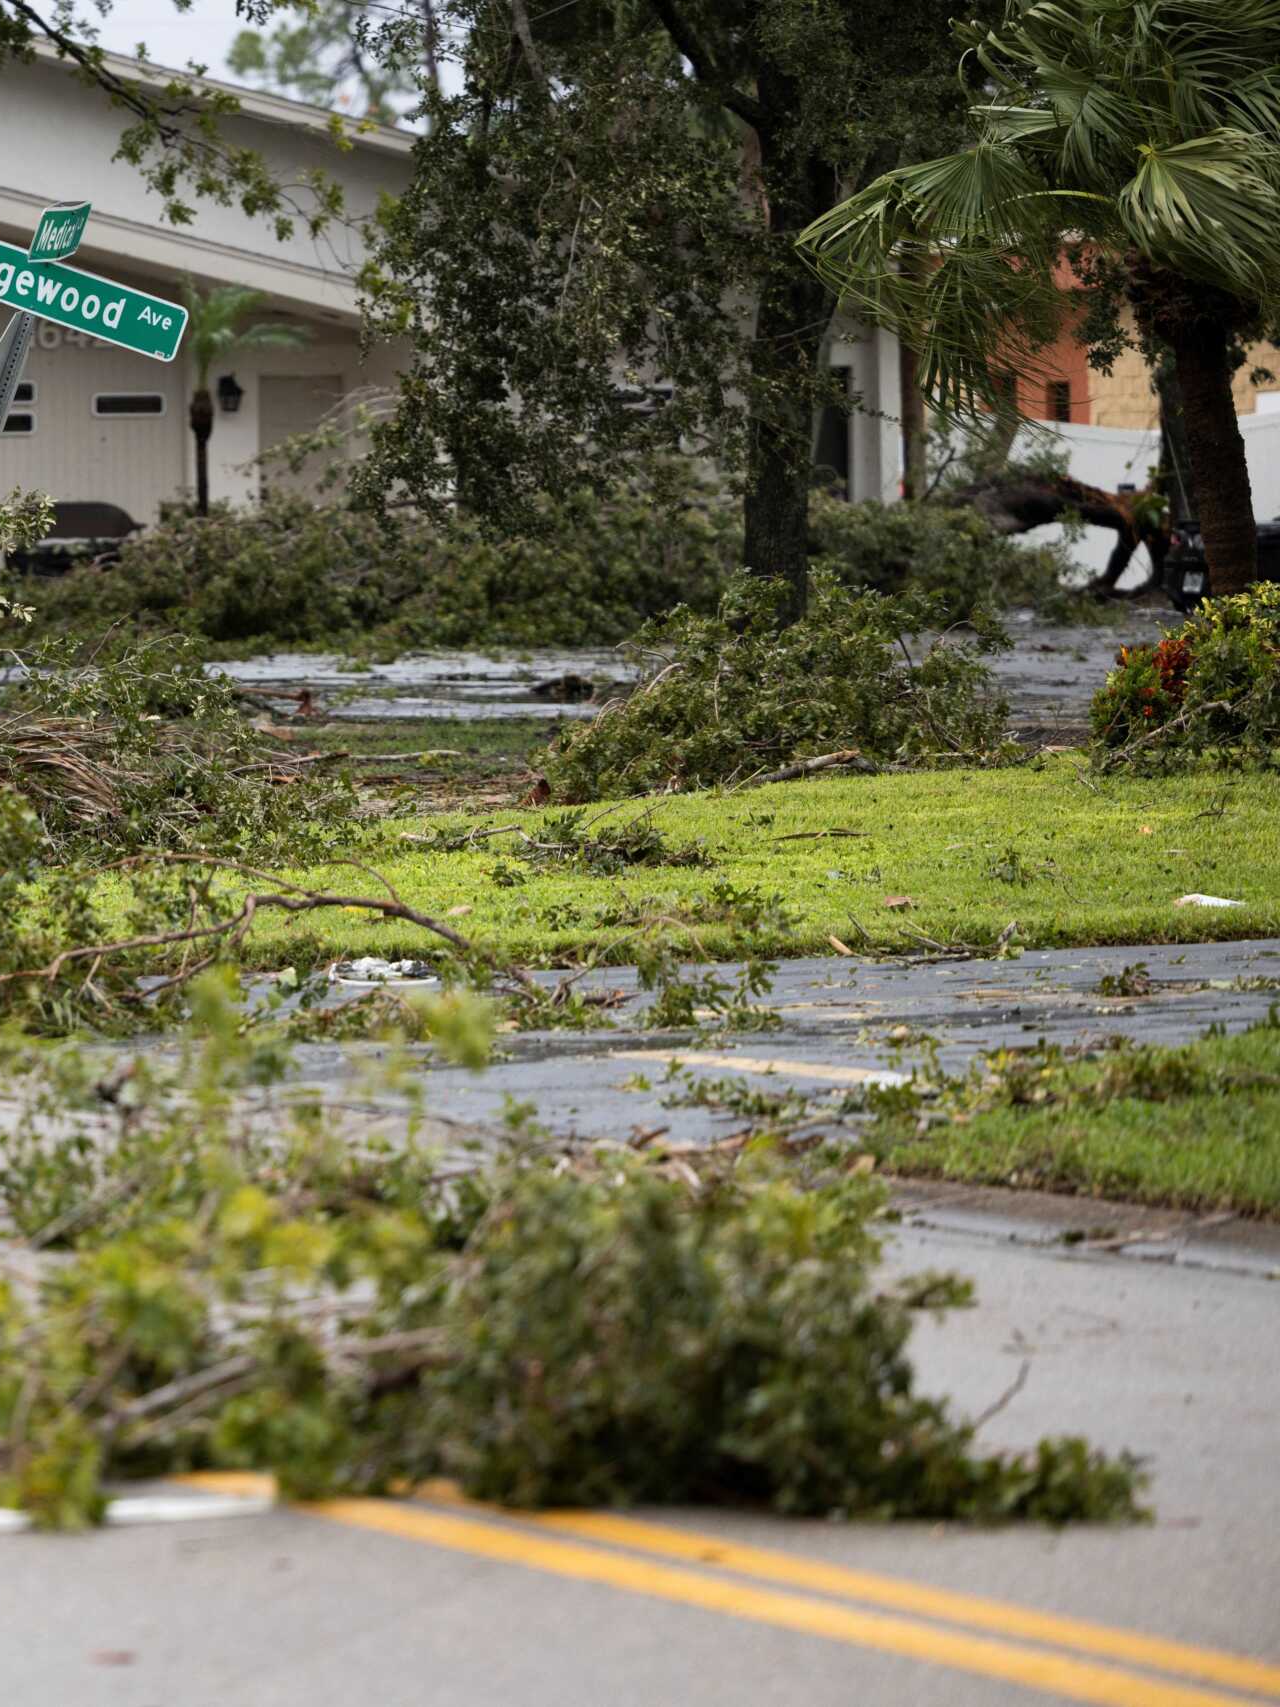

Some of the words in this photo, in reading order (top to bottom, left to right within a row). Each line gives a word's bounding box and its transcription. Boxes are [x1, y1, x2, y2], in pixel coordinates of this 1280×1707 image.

[36, 218, 76, 251] Medica
[30, 318, 114, 350] 64
[137, 305, 172, 331] Ave
